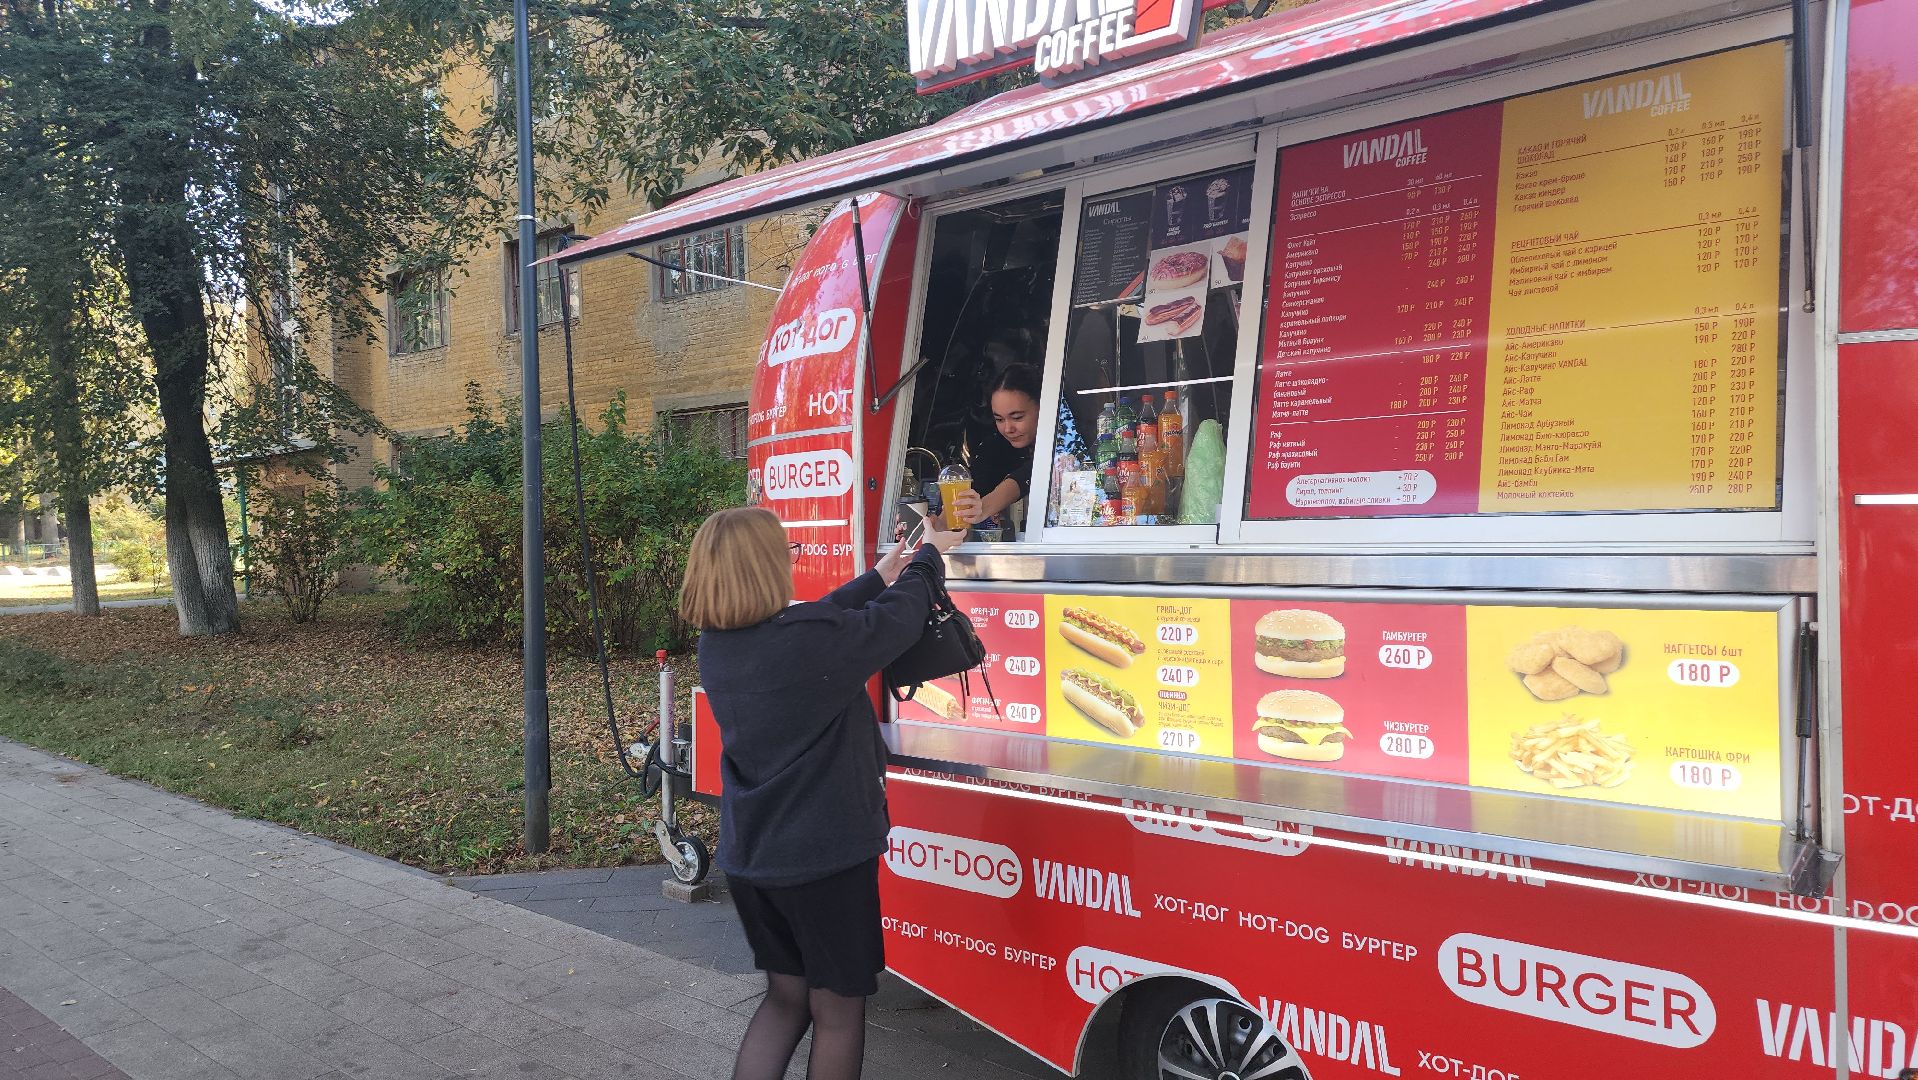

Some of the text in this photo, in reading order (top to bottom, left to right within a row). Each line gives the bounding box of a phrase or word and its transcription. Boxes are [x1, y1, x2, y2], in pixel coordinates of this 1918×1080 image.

[907, 0, 1133, 74] VAND
[1034, 8, 1134, 73] COFFEE
[1583, 72, 1692, 119] VANDAL
[1651, 100, 1691, 117] COFFEE
[1343, 128, 1428, 168] VANDAL
[1395, 152, 1427, 168] COFFEE
[1516, 170, 1538, 180] Какао
[1515, 181, 1538, 191] Какао
[1088, 201, 1120, 218] VANDAL
[1513, 199, 1544, 213] Горячий
[1564, 231, 1580, 240] ЧАЙ
[1698, 227, 1713, 237] 120
[808, 388, 853, 417] HOT
[1728, 458, 1744, 468] 220
[769, 459, 841, 490] BURGER
[1496, 490, 1536, 500] Молочный
[1728, 483, 1744, 493] 280
[1008, 612, 1035, 626] 220 Р
[1156, 605, 1193, 616] ГРИЛЬ-ДОГ
[1161, 626, 1193, 642] 220 Р
[1382, 630, 1428, 642] ГАМБУРГЕР
[1385, 647, 1426, 665] 260 Р
[1664, 643, 1743, 657] НАГГЕТСЫ 6шт
[1010, 659, 1026, 672] 240
[1030, 660, 1036, 674] Р
[1677, 662, 1731, 683] 180 Р
[1162, 668, 1194, 684] 240 Р
[1010, 705, 1027, 720] 240
[1030, 707, 1037, 721] Р
[1383, 720, 1430, 734] ЧИЗБУРГЕР
[1162, 731, 1195, 748] 270 Р
[1386, 736, 1428, 755] 280 Р
[1665, 746, 1750, 763] КАРТОШКА ФРИ
[1679, 764, 1732, 786] 180 Р
[889, 837, 1018, 886] HOT-DOG
[1032, 857, 1418, 962] VANDAL ХОТ-ДОГ HOT-DOG БУРГЕР
[881, 915, 1057, 971] ОТ-ДОГ HOT-DOG БУРГЕР
[1456, 944, 1702, 1036] BURGER
[1259, 995, 1401, 1077] VANDAL
[1756, 998, 1918, 1079] VAND
